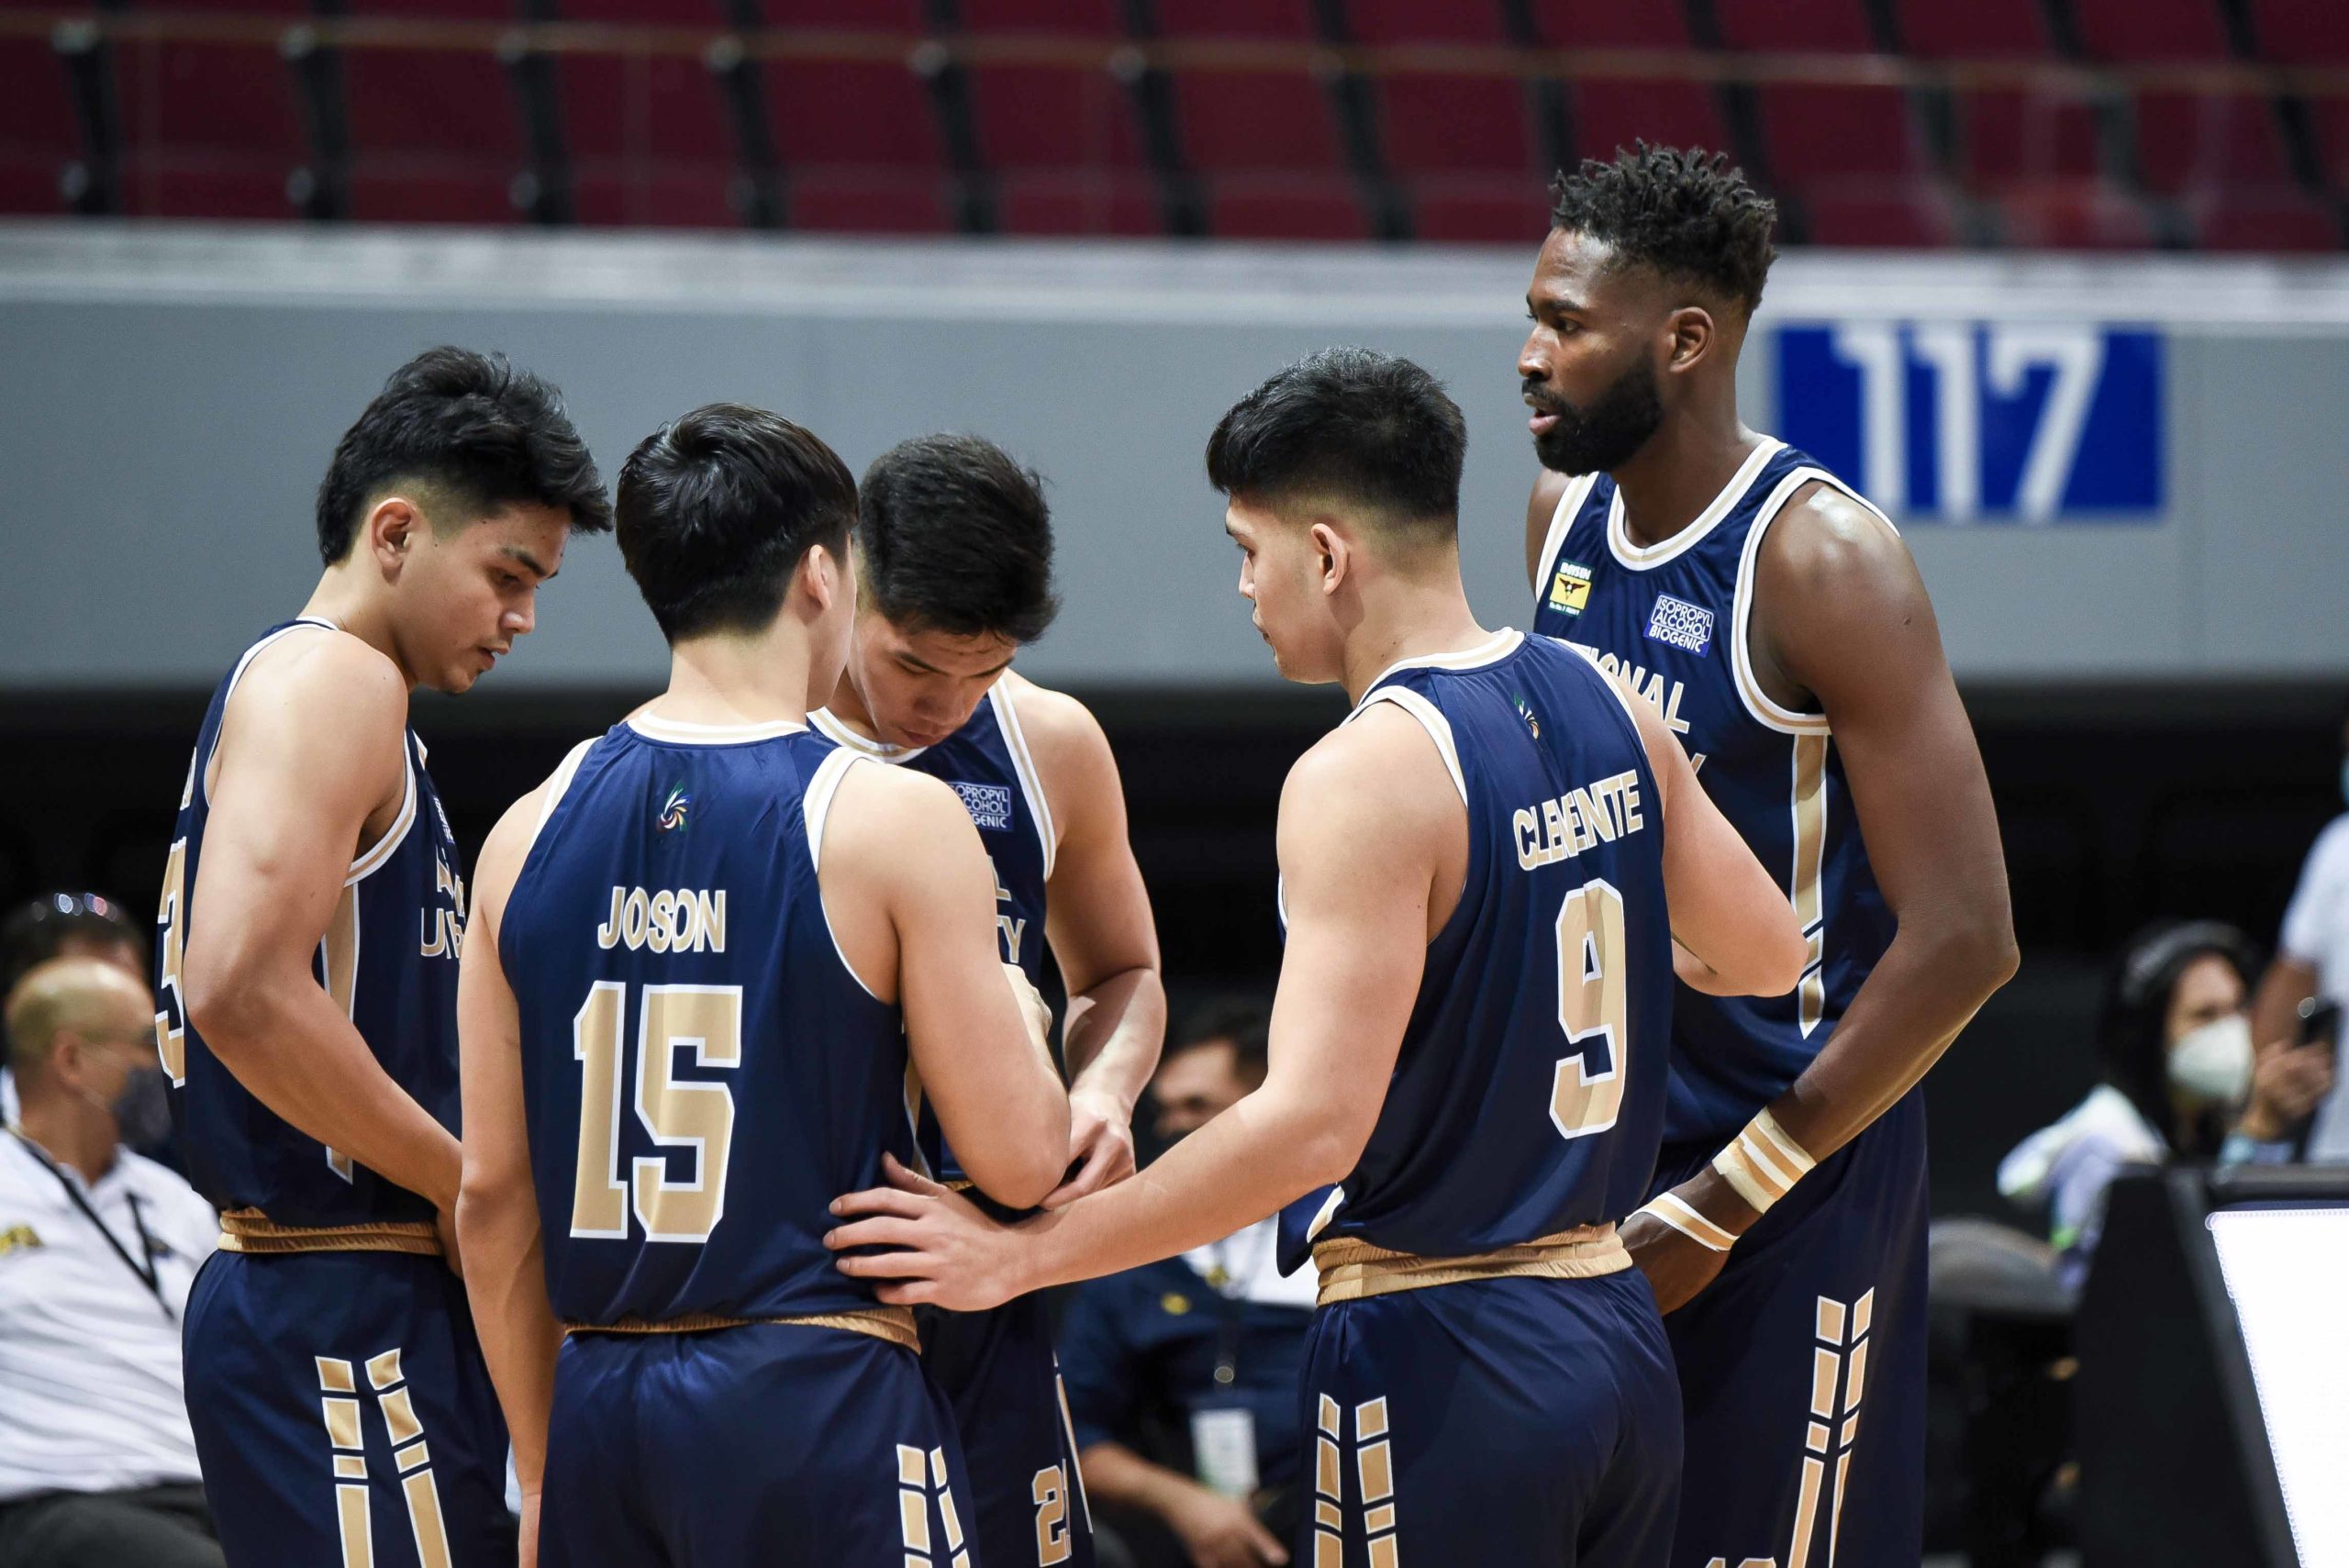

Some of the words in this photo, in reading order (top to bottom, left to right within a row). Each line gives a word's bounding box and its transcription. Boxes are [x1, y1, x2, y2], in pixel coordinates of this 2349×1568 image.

[1831, 321, 2103, 523] 117
[1653, 610, 1707, 639] ALCOHOL
[1656, 597, 1710, 628] ISOPROPYL
[1649, 624, 1704, 653] BIOGENIC
[1578, 644, 1690, 734] ONAL
[948, 784, 1008, 802] OPROPYL
[963, 796, 1006, 814] COHOL
[971, 813, 1008, 828] GENIC
[597, 886, 726, 953] JOSON
[1549, 877, 1628, 1140] 9
[570, 980, 742, 1243] 15
